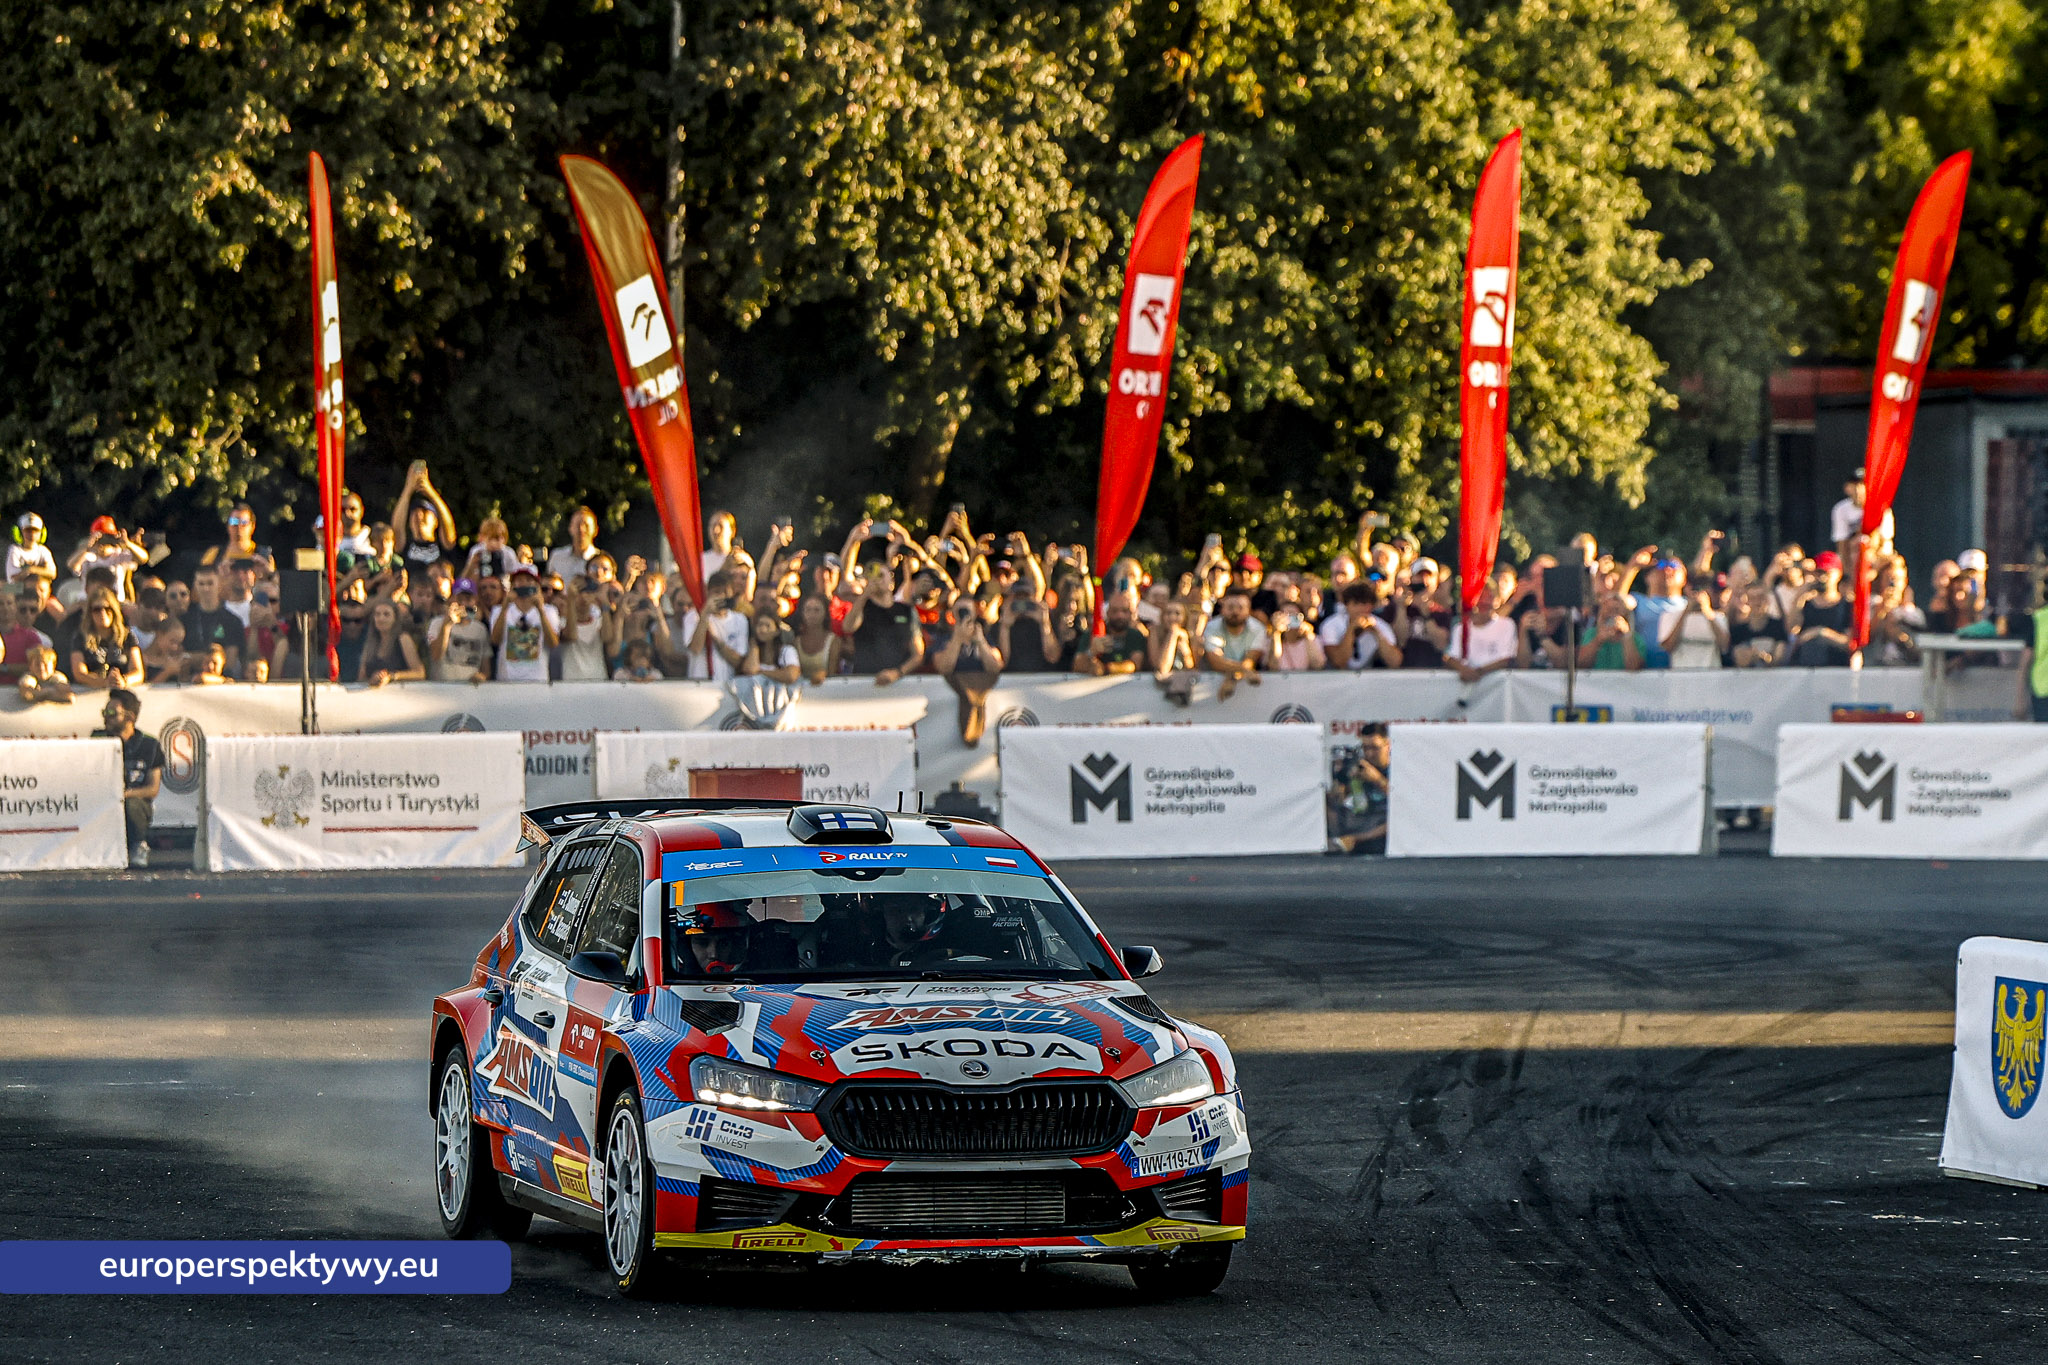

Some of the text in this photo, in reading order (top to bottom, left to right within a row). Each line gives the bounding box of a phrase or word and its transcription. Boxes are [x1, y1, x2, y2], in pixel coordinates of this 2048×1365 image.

[321, 770, 440, 789] Ministerstwo
[321, 793, 479, 815] Sportu i Turystyki
[827, 1006, 1074, 1031] AMSOIL
[476, 1016, 556, 1120] AMSOIL
[715, 1134, 750, 1151] INVEST
[1140, 1148, 1200, 1173] WW-119-ZY
[555, 1163, 586, 1195] PIRELLI
[733, 1232, 807, 1249] PIRELLI
[1145, 1225, 1201, 1241] PIRELLI
